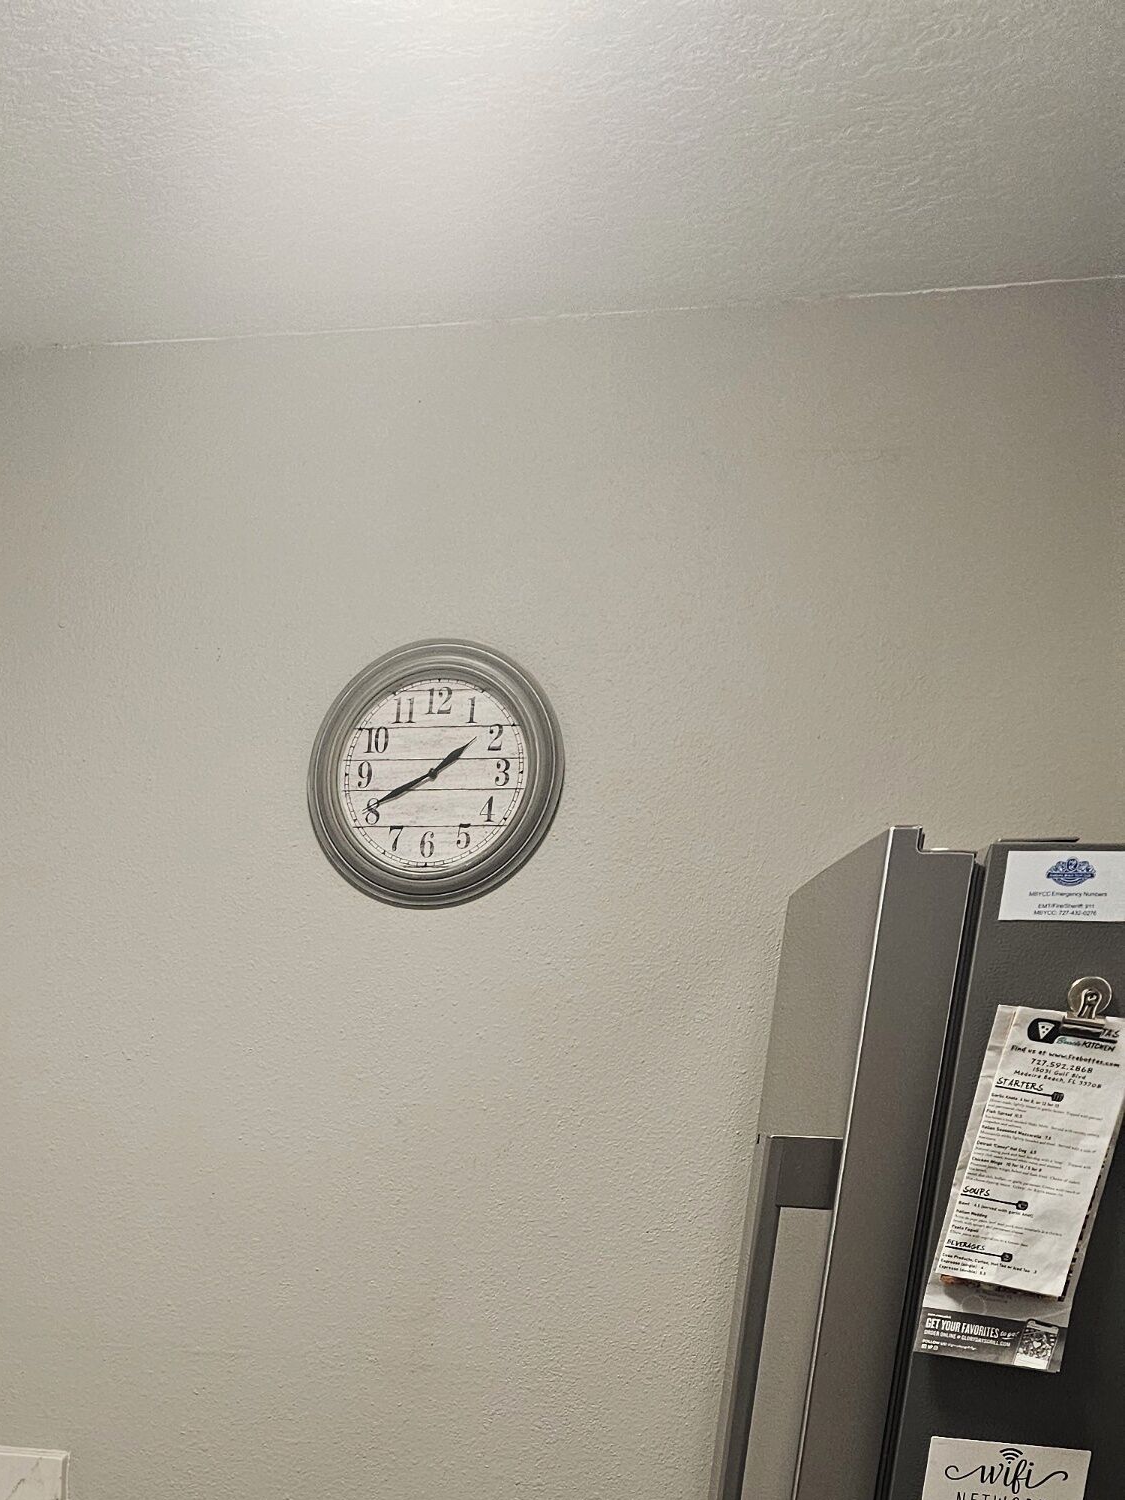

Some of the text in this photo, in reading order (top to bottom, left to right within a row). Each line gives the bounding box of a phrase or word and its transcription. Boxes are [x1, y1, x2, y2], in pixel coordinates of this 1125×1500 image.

[391, 697, 416, 724] 11
[425, 686, 453, 715] 12
[466, 696, 478, 724] 1
[363, 726, 389, 753] 10
[487, 724, 504, 751] 2
[358, 761, 373, 789] 9
[495, 758, 510, 786] 3
[365, 798, 380, 825] 8
[480, 796, 495, 822] 4
[389, 825, 404, 852] 7
[420, 831, 435, 858] 6
[456, 823, 471, 849] 5
[1010, 1044, 1026, 1054] Find
[1082, 1040, 1116, 1052] KITCHEN
[1030, 1058, 1093, 1074] 727.592.2868
[996, 1076, 1044, 1092] STARTERS
[962, 1185, 990, 1196] SOUPS
[946, 1238, 986, 1250] BEVERAGES
[924, 1329, 940, 1337] ORDER
[940, 1332, 956, 1340] ONLINE
[925, 1318, 941, 1330] GET
[941, 1320, 960, 1332] YOUR
[961, 1322, 1000, 1338] FAVORITES
